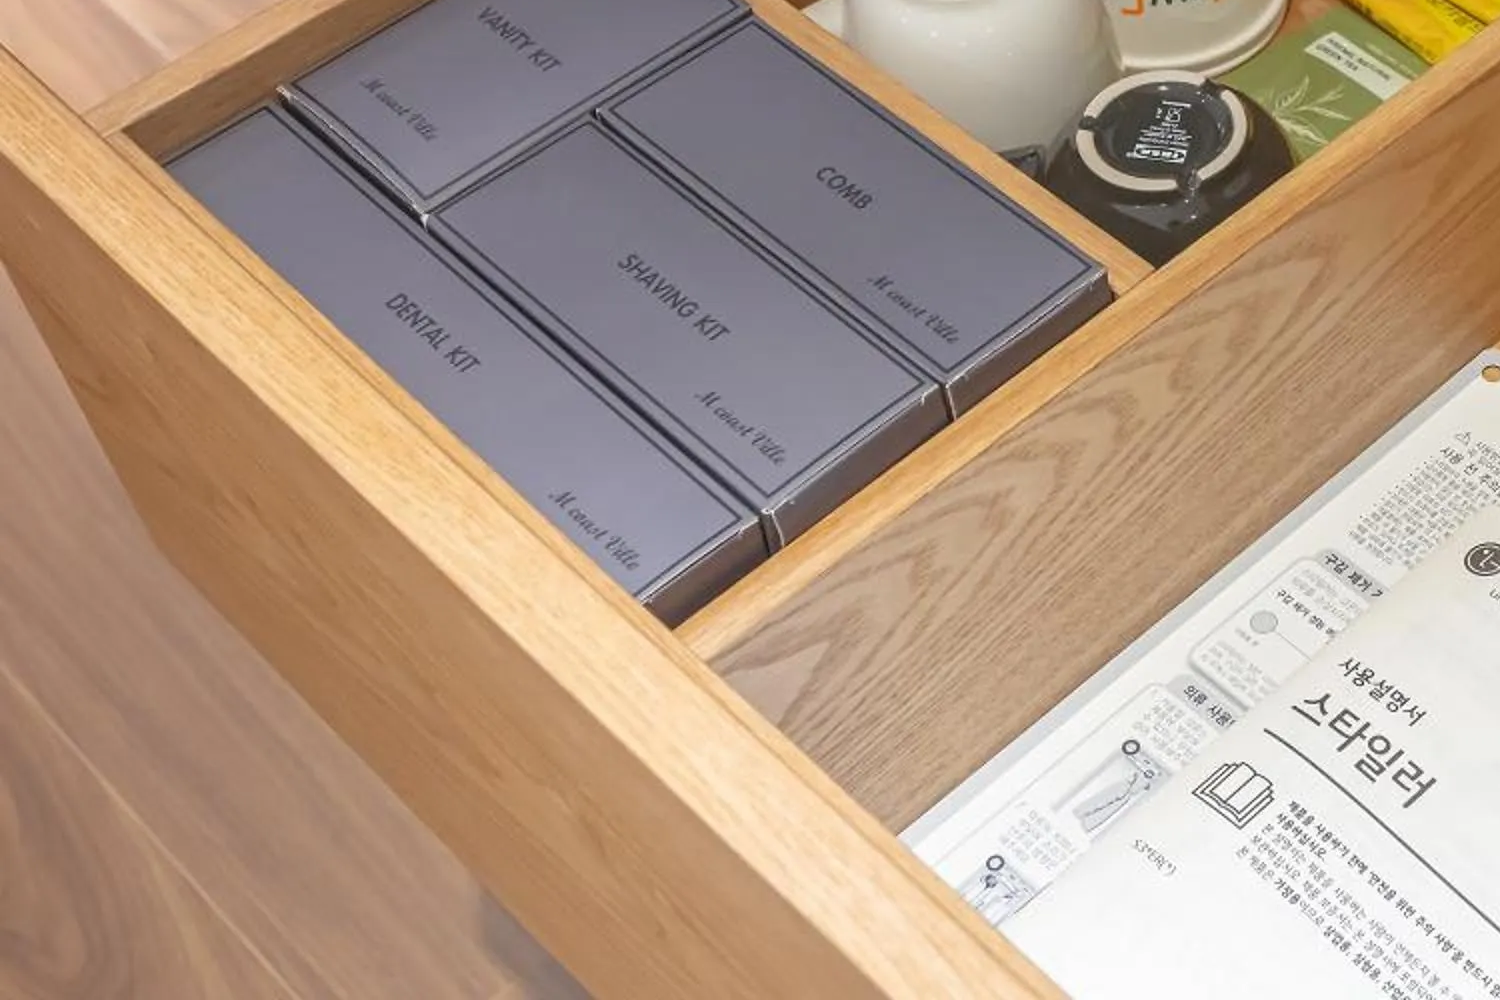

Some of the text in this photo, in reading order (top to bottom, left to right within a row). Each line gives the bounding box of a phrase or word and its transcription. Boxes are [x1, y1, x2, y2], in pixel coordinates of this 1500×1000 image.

[477, 6, 564, 73] VANITY KIT
[816, 166, 873, 209] COMB
[617, 253, 731, 341] SHAVING KIT
[385, 293, 481, 373] DENTAL KIT
[1440, 447, 1464, 464] 사용
[1338, 658, 1427, 727] 사용설명서
[1291, 693, 1437, 808] 스타일러
